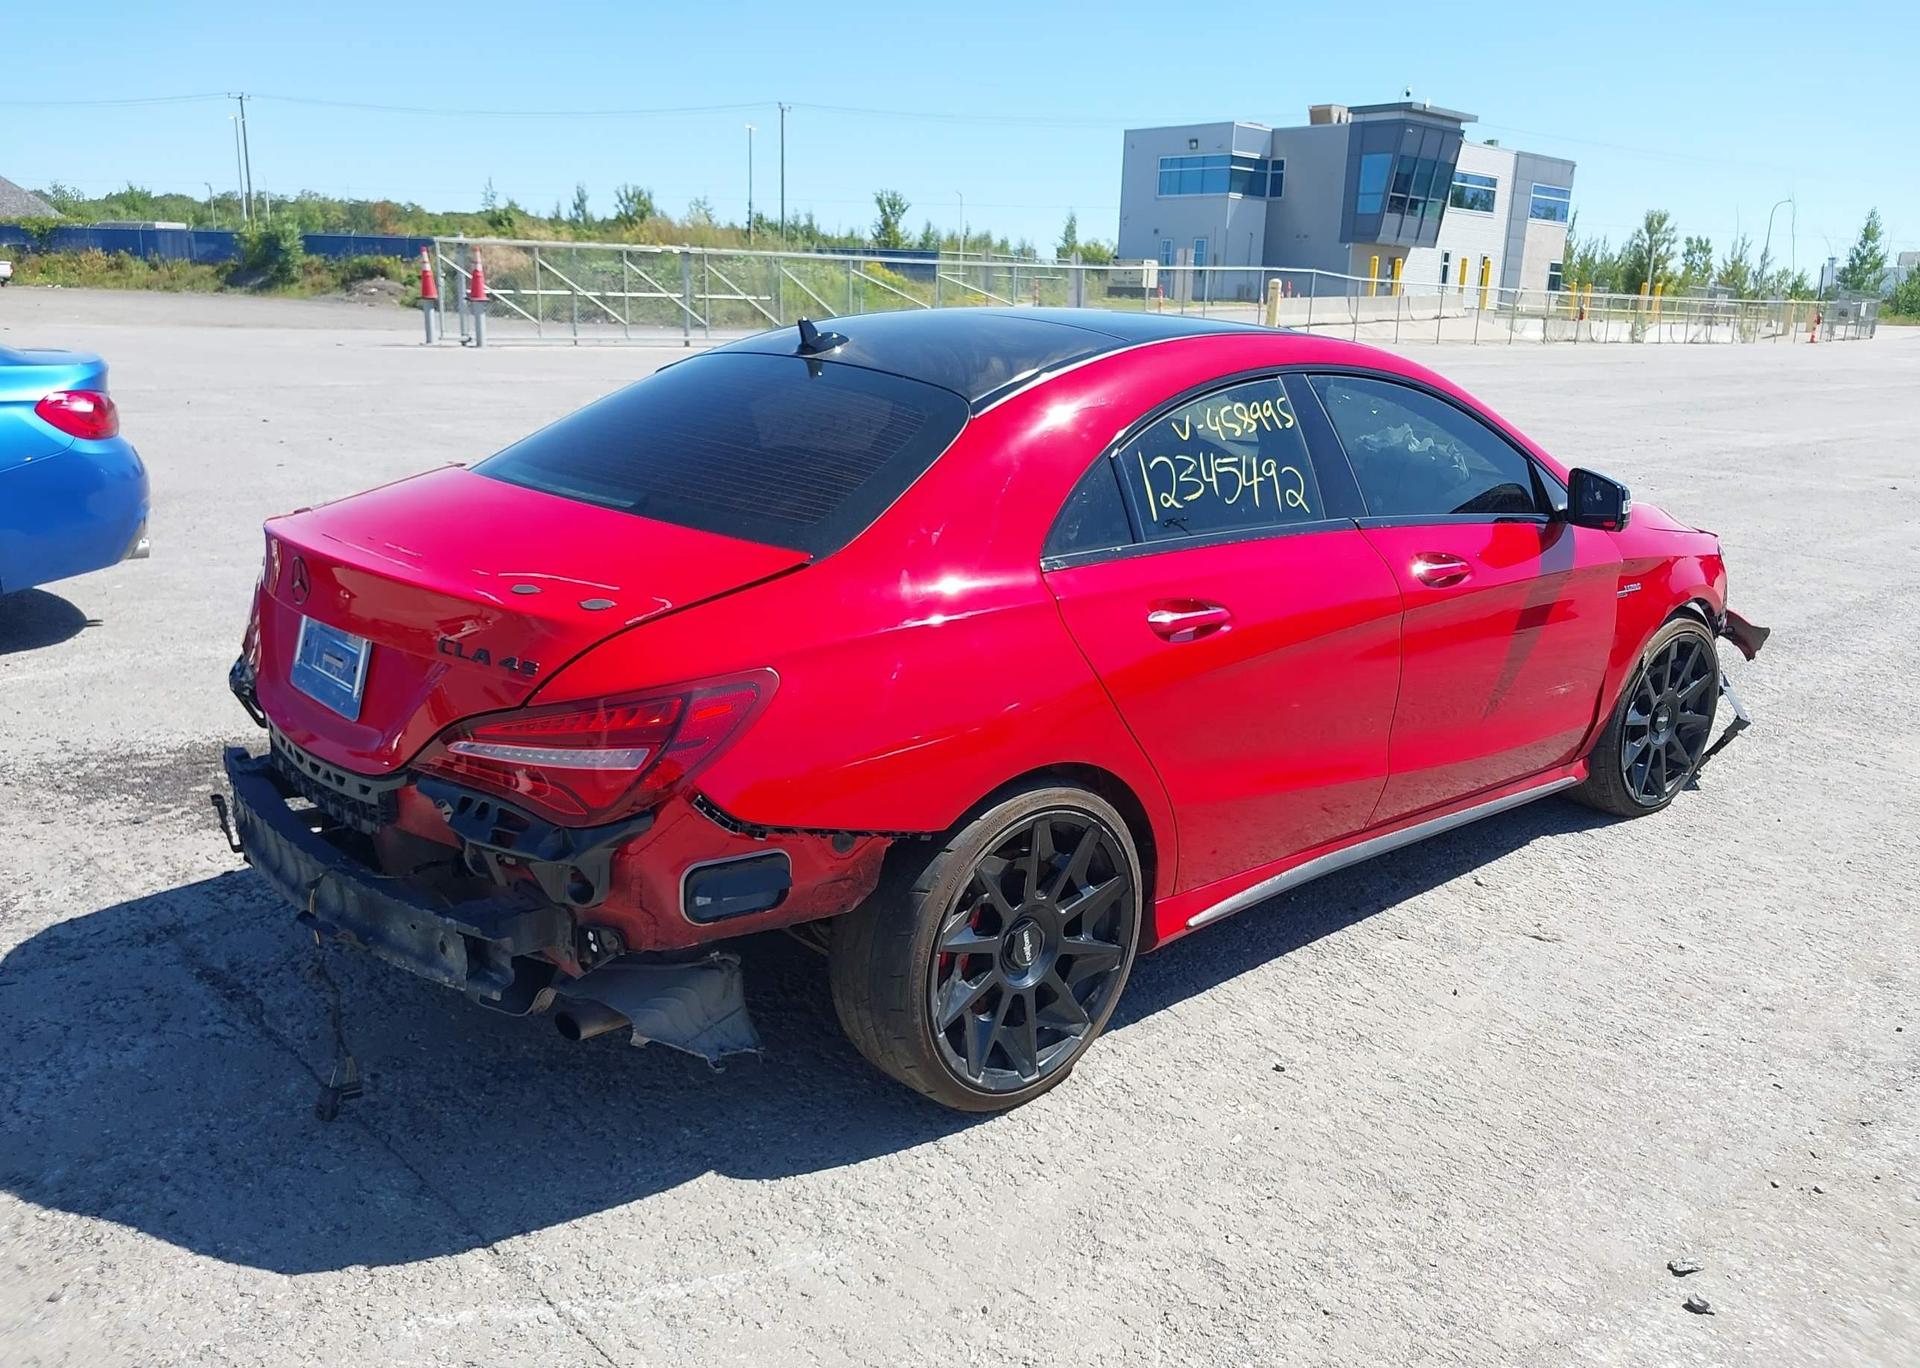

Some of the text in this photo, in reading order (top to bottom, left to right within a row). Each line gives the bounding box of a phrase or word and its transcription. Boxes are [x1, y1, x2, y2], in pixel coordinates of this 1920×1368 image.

[1138, 451, 1311, 522] 12345492
[438, 638, 540, 677] CLA 45
